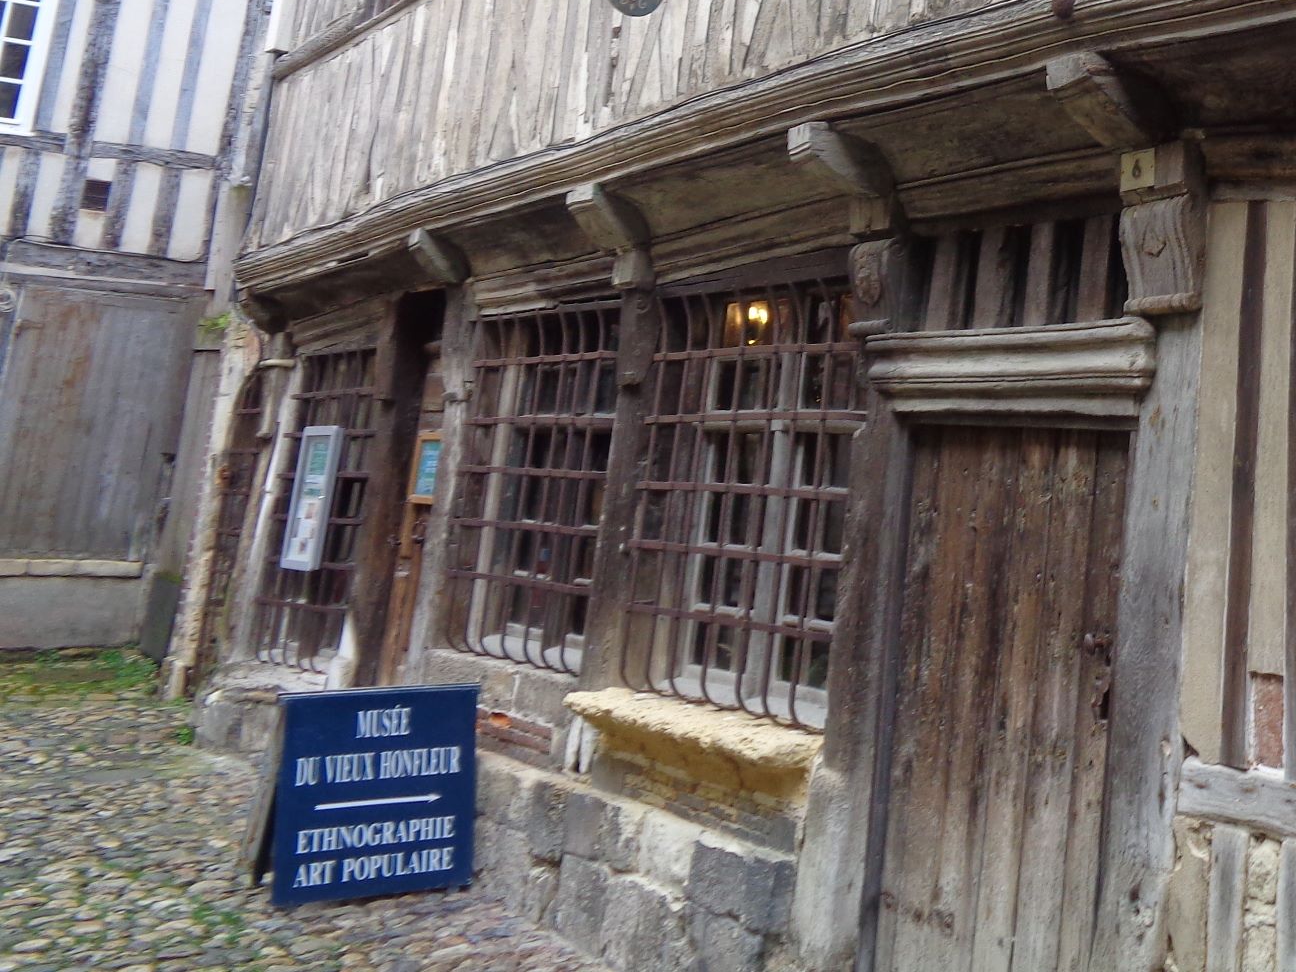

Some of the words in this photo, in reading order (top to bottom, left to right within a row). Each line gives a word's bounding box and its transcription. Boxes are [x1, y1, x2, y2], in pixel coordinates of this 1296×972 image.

[1131, 157, 1142, 180] 6
[356, 704, 412, 739] MUSÉE
[294, 756, 321, 787] DU
[325, 752, 376, 783] VIEUX
[379, 746, 462, 780] HONFLEUR
[296, 815, 456, 855] ETHNOGRAPHIE
[293, 860, 336, 889] ART
[341, 846, 455, 883] POPULAIRE
